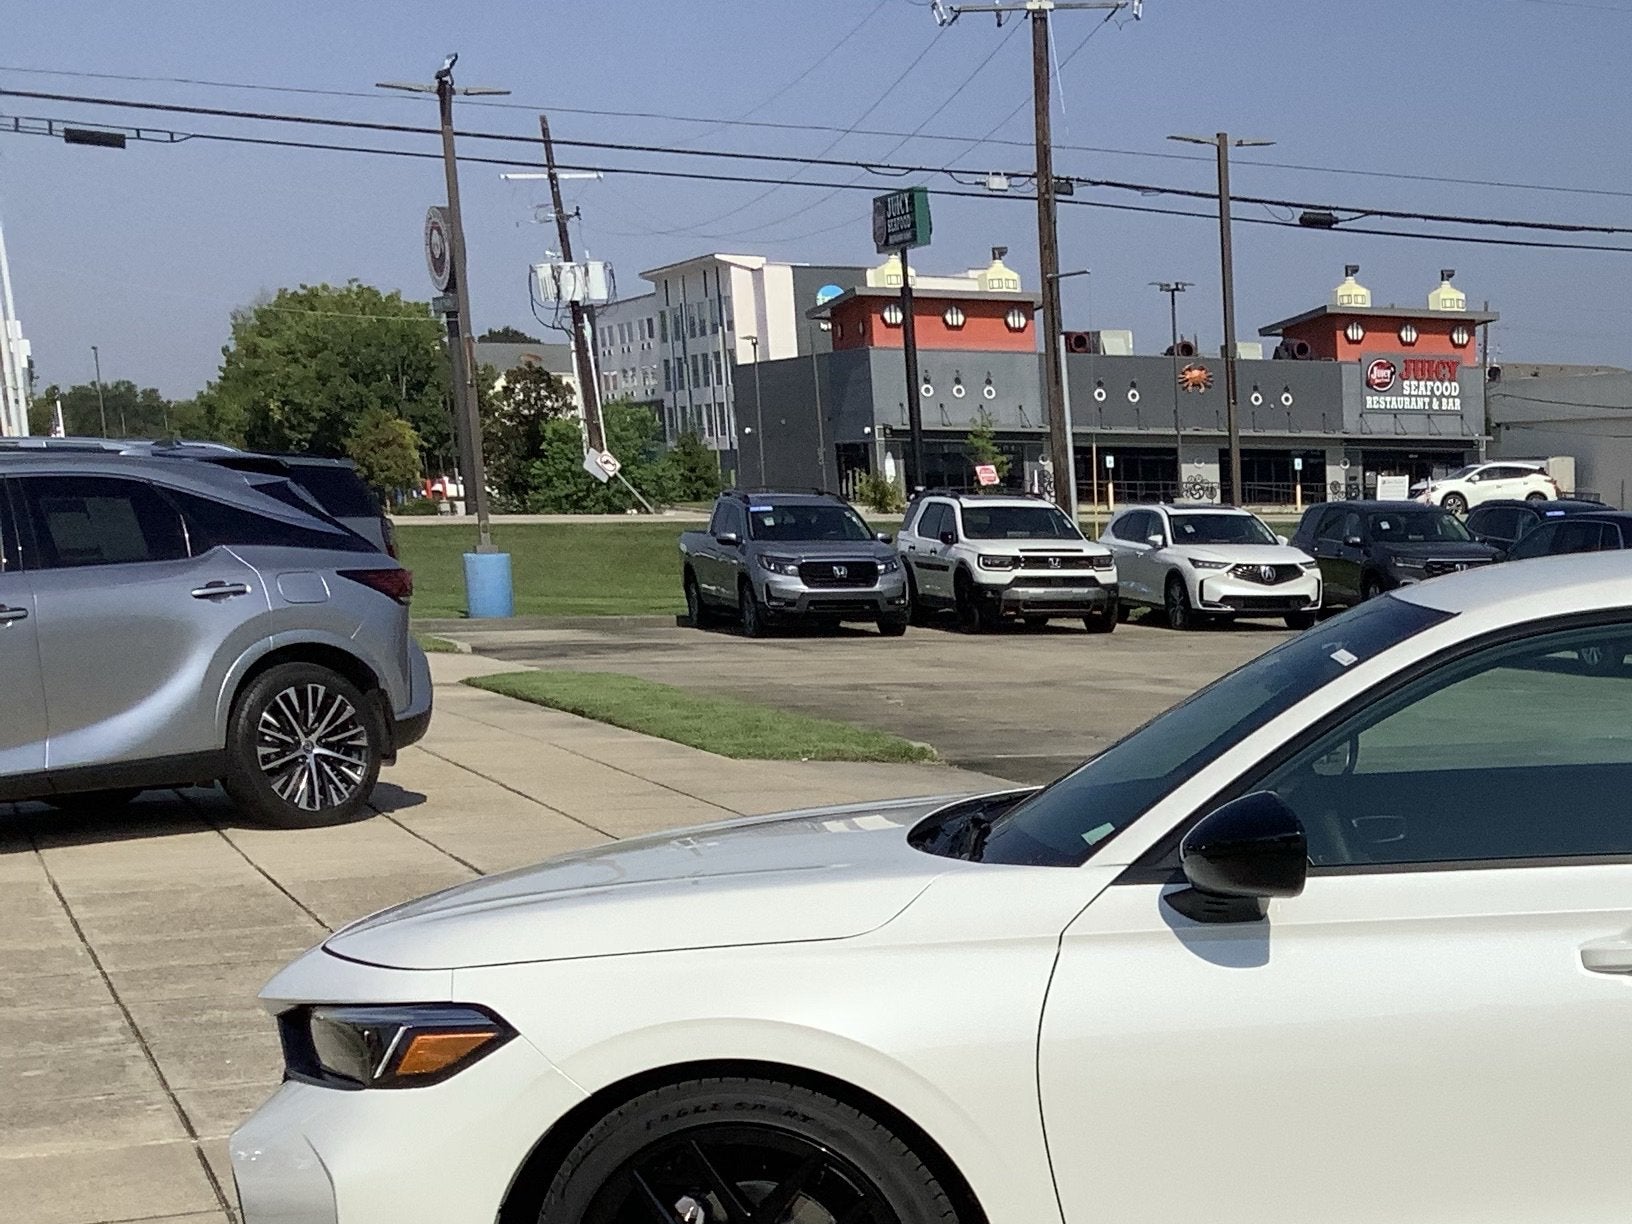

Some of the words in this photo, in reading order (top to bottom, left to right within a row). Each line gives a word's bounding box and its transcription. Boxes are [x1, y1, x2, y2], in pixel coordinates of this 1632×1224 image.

[887, 192, 910, 218] JUICY
[1399, 359, 1460, 381] JUICY
[1403, 380, 1460, 396] SEAFOOD
[1366, 395, 1430, 410] RESTAURANT
[1432, 398, 1439, 410] &
[1441, 398, 1461, 411] BAR
